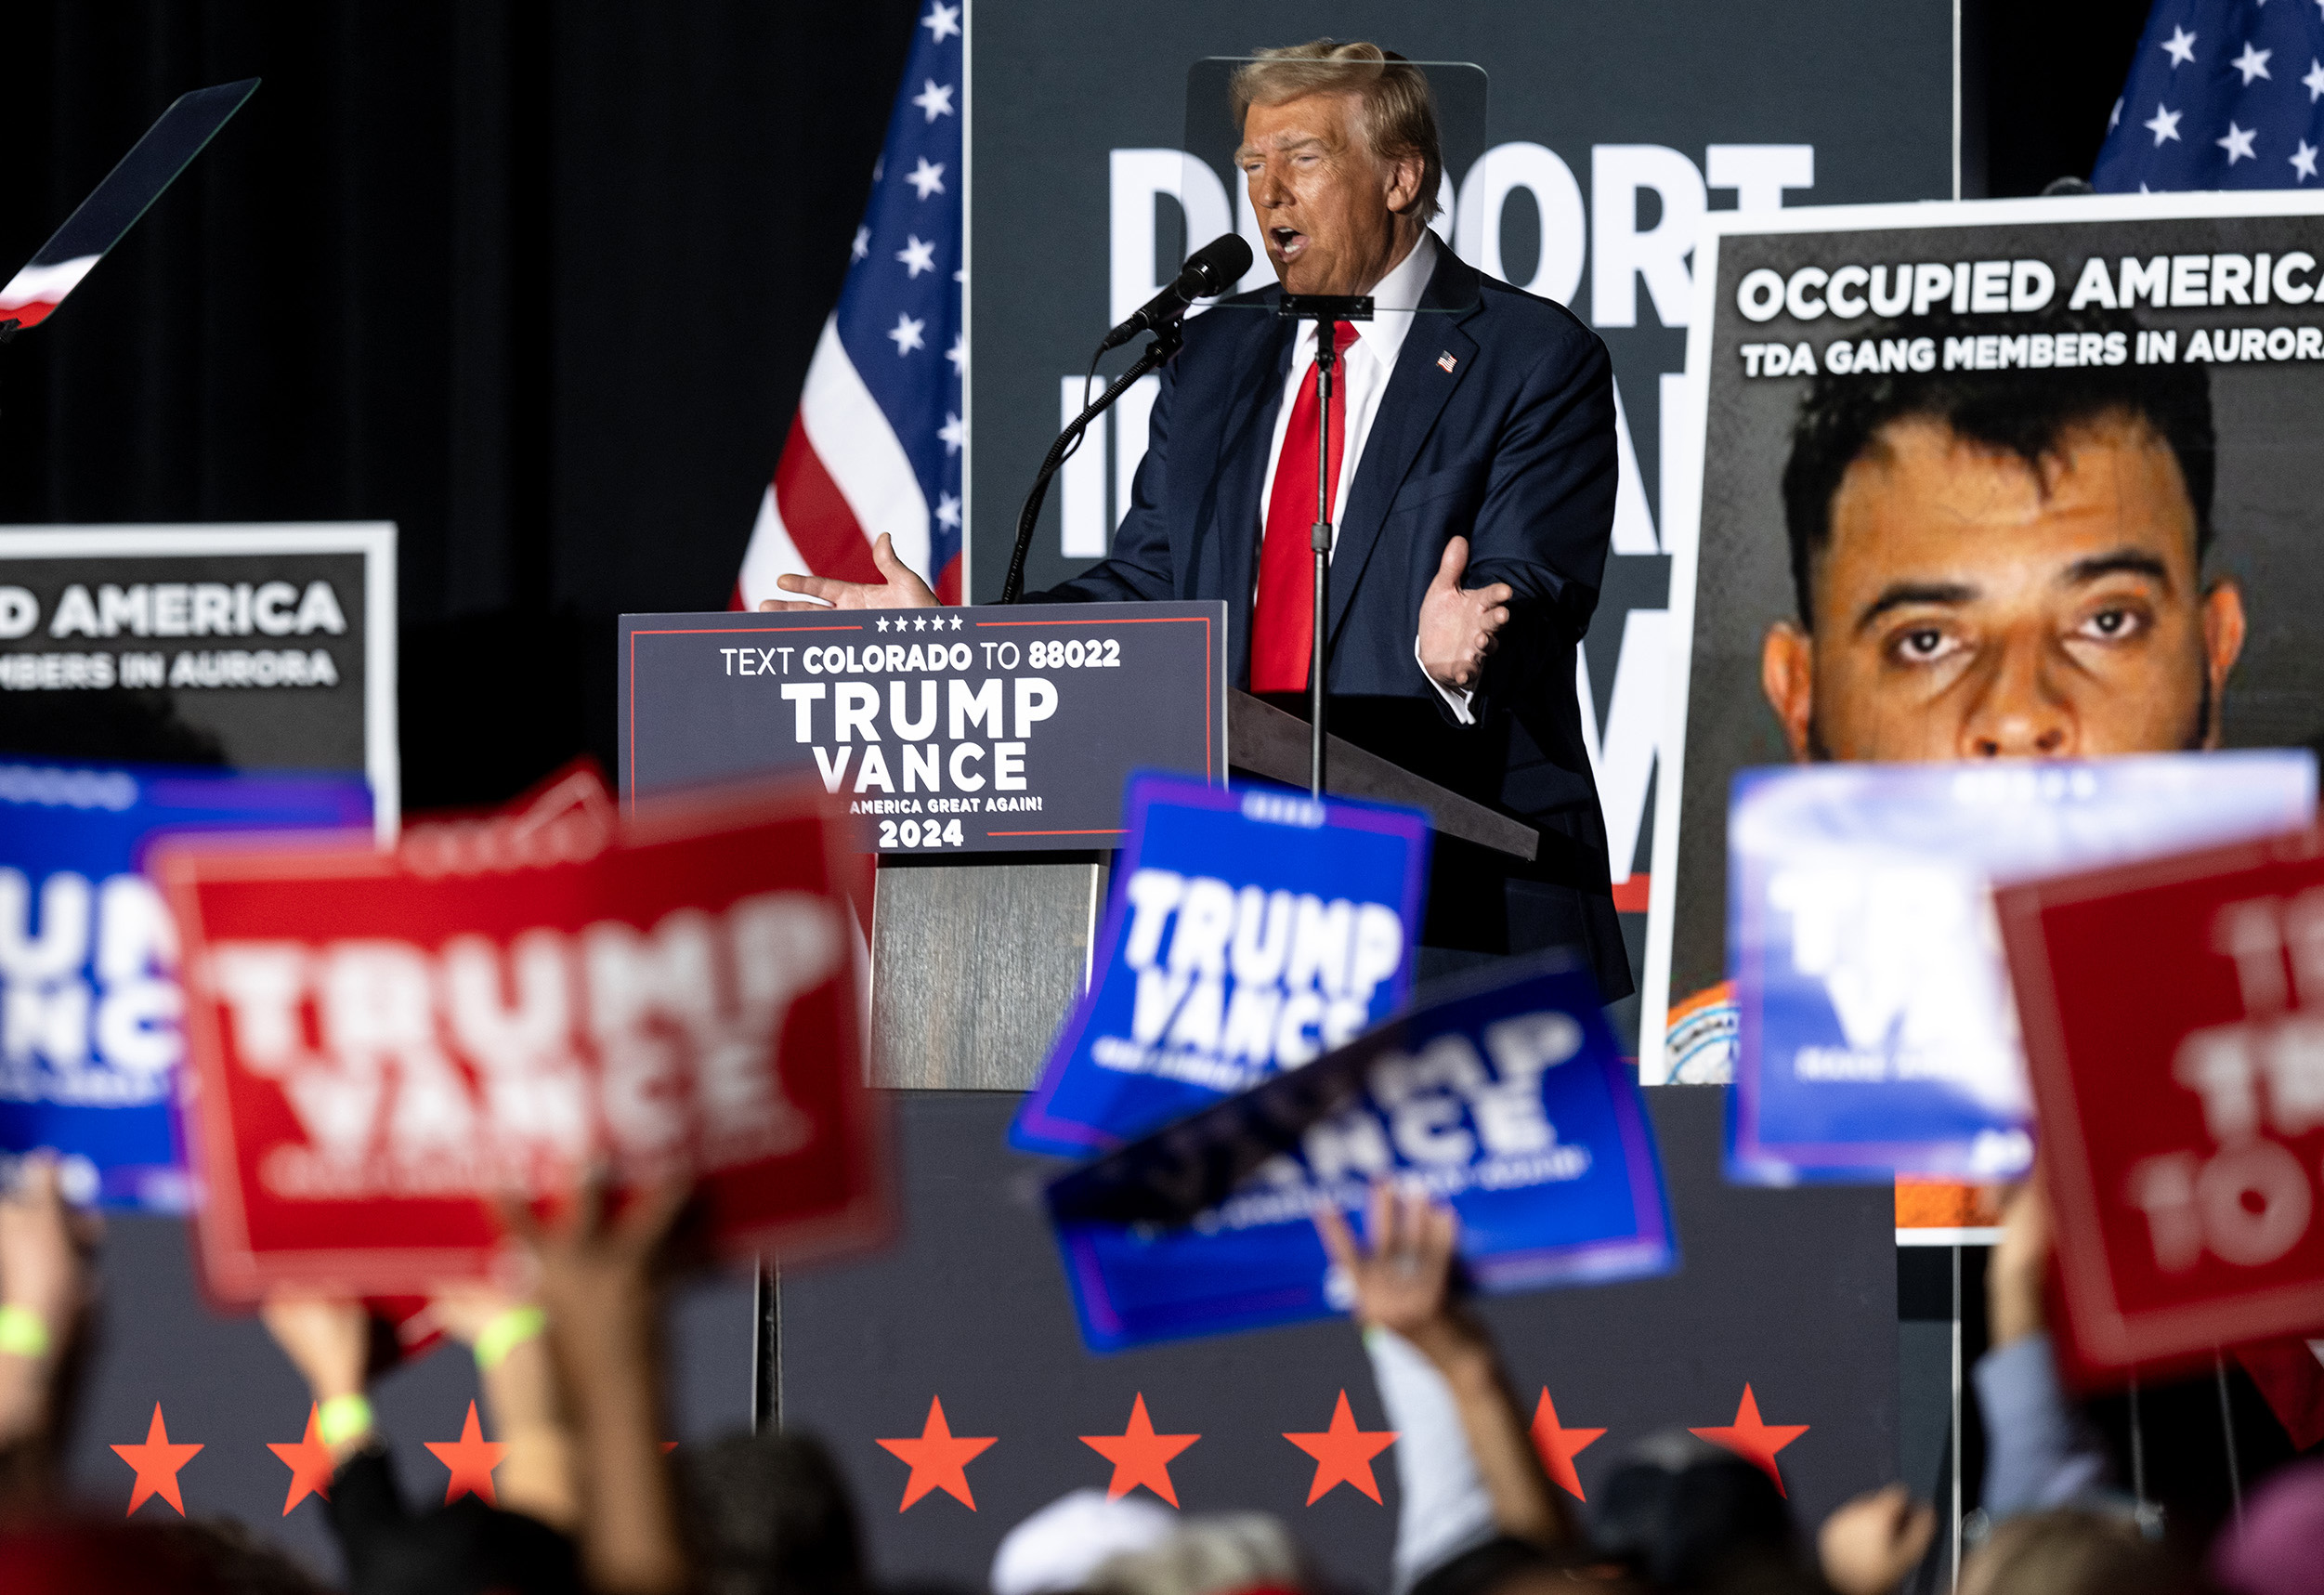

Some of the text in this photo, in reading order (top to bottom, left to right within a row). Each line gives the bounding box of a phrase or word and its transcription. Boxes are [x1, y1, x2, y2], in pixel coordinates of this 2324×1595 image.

[1737, 251, 2324, 321] OCCUPIED AMERIC
[1740, 326, 2324, 377] TDA GANG MEMBERS IN AUROR
[48, 581, 347, 638] AMERICA
[119, 651, 166, 688] IN
[168, 649, 339, 687] AURORA
[720, 638, 1121, 676] TEXT COLORADO TO 88022
[780, 677, 1059, 744] TRUMP
[811, 741, 1027, 794] VANCE
[849, 796, 1043, 816] AMERICA GREAT AGAIN!
[879, 818, 964, 849] 2024
[1124, 865, 1405, 1003] TRUMP
[190, 890, 845, 1079] TRUMP
